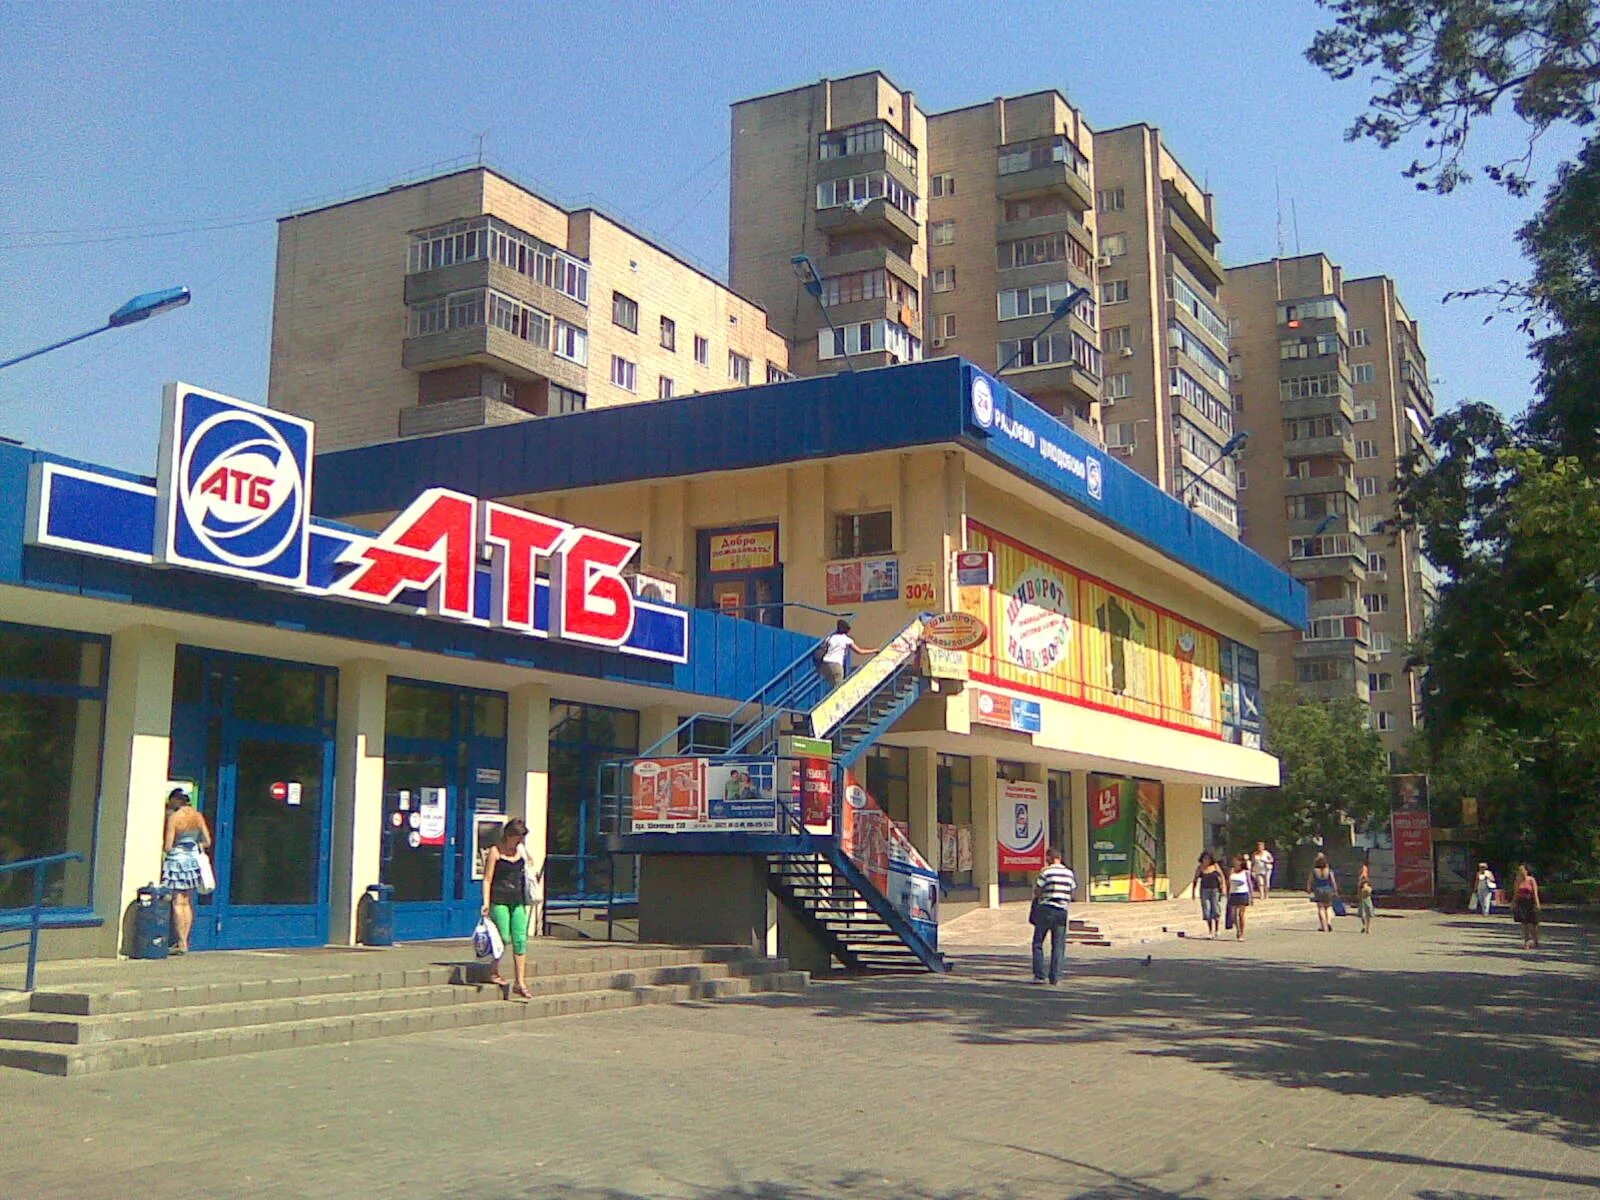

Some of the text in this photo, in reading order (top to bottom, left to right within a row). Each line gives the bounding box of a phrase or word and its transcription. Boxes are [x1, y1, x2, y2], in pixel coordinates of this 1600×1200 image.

[200, 466, 276, 511] АТБ
[721, 535, 756, 549] Добро
[345, 487, 641, 647] АТБ
[906, 583, 934, 601] 30%
[1007, 577, 1064, 625] ШИВОРОТ
